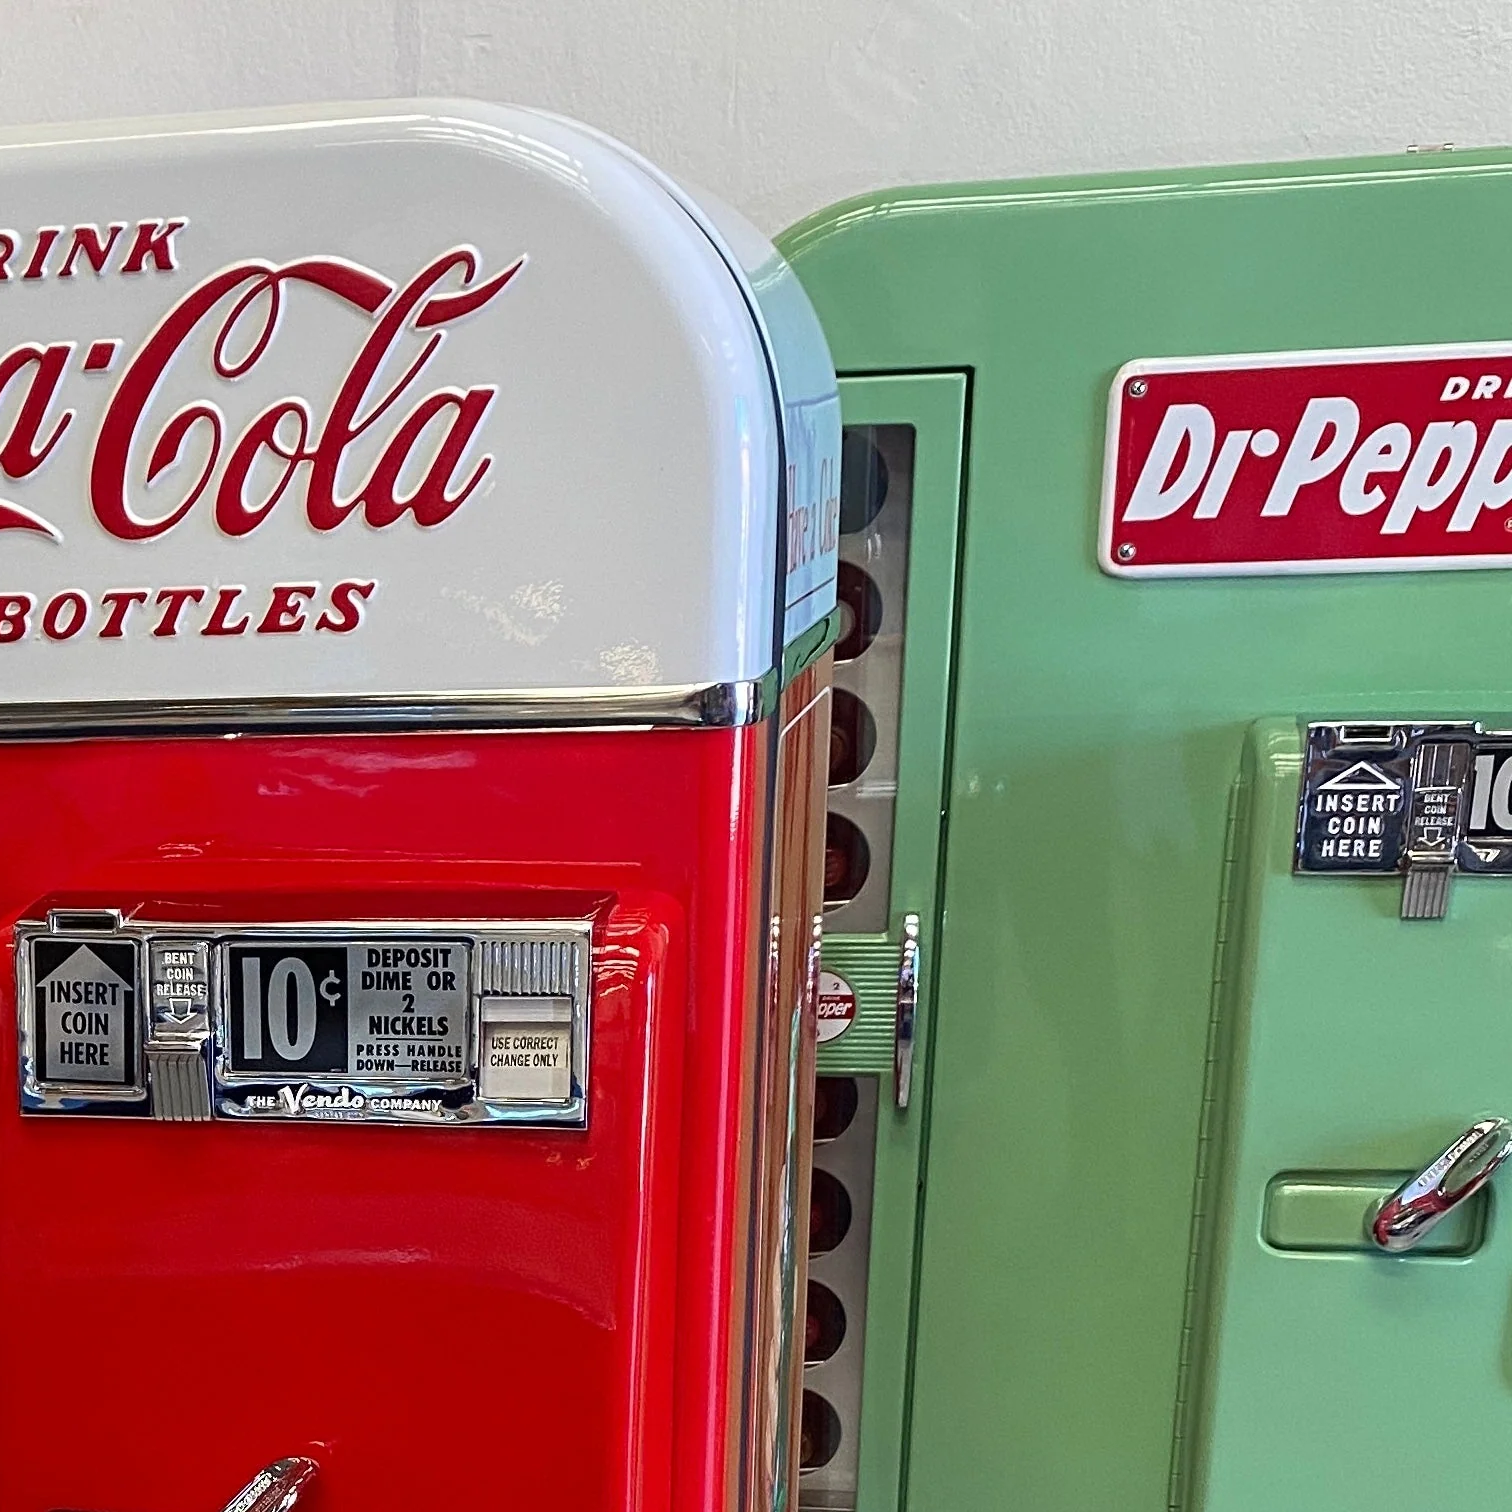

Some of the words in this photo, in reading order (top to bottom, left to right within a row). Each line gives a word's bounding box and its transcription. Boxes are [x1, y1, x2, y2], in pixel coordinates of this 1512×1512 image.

[1315, 793, 1400, 813] INSERT
[1423, 793, 1450, 804] BENT
[1424, 805, 1447, 815] COIN
[1327, 816, 1382, 835] COIN
[1414, 816, 1455, 826] RELEASE
[1321, 839, 1382, 858] HERE
[164, 952, 196, 965] BENT
[367, 948, 452, 969] DEPOSIT
[166, 968, 194, 981] COIN
[361, 971, 412, 991] DIME
[426, 971, 456, 991] OR
[49, 980, 120, 1006] INSERT
[156, 983, 204, 996] RELEASE
[402, 993, 415, 1013] 2
[61, 1011, 109, 1036] COIN
[368, 1015, 449, 1037] NICKELS
[356, 1044, 400, 1057] PRESS
[407, 1044, 462, 1058] HANDLE
[491, 1036, 511, 1049] USE
[513, 1036, 559, 1050] CORRECT
[59, 1041, 110, 1066] HERE
[490, 1053, 531, 1067] CHANGE
[532, 1053, 559, 1067] ONLY
[248, 1095, 276, 1107] THE
[277, 1083, 365, 1114] Vendo
[370, 1098, 443, 1111] COMPANY
